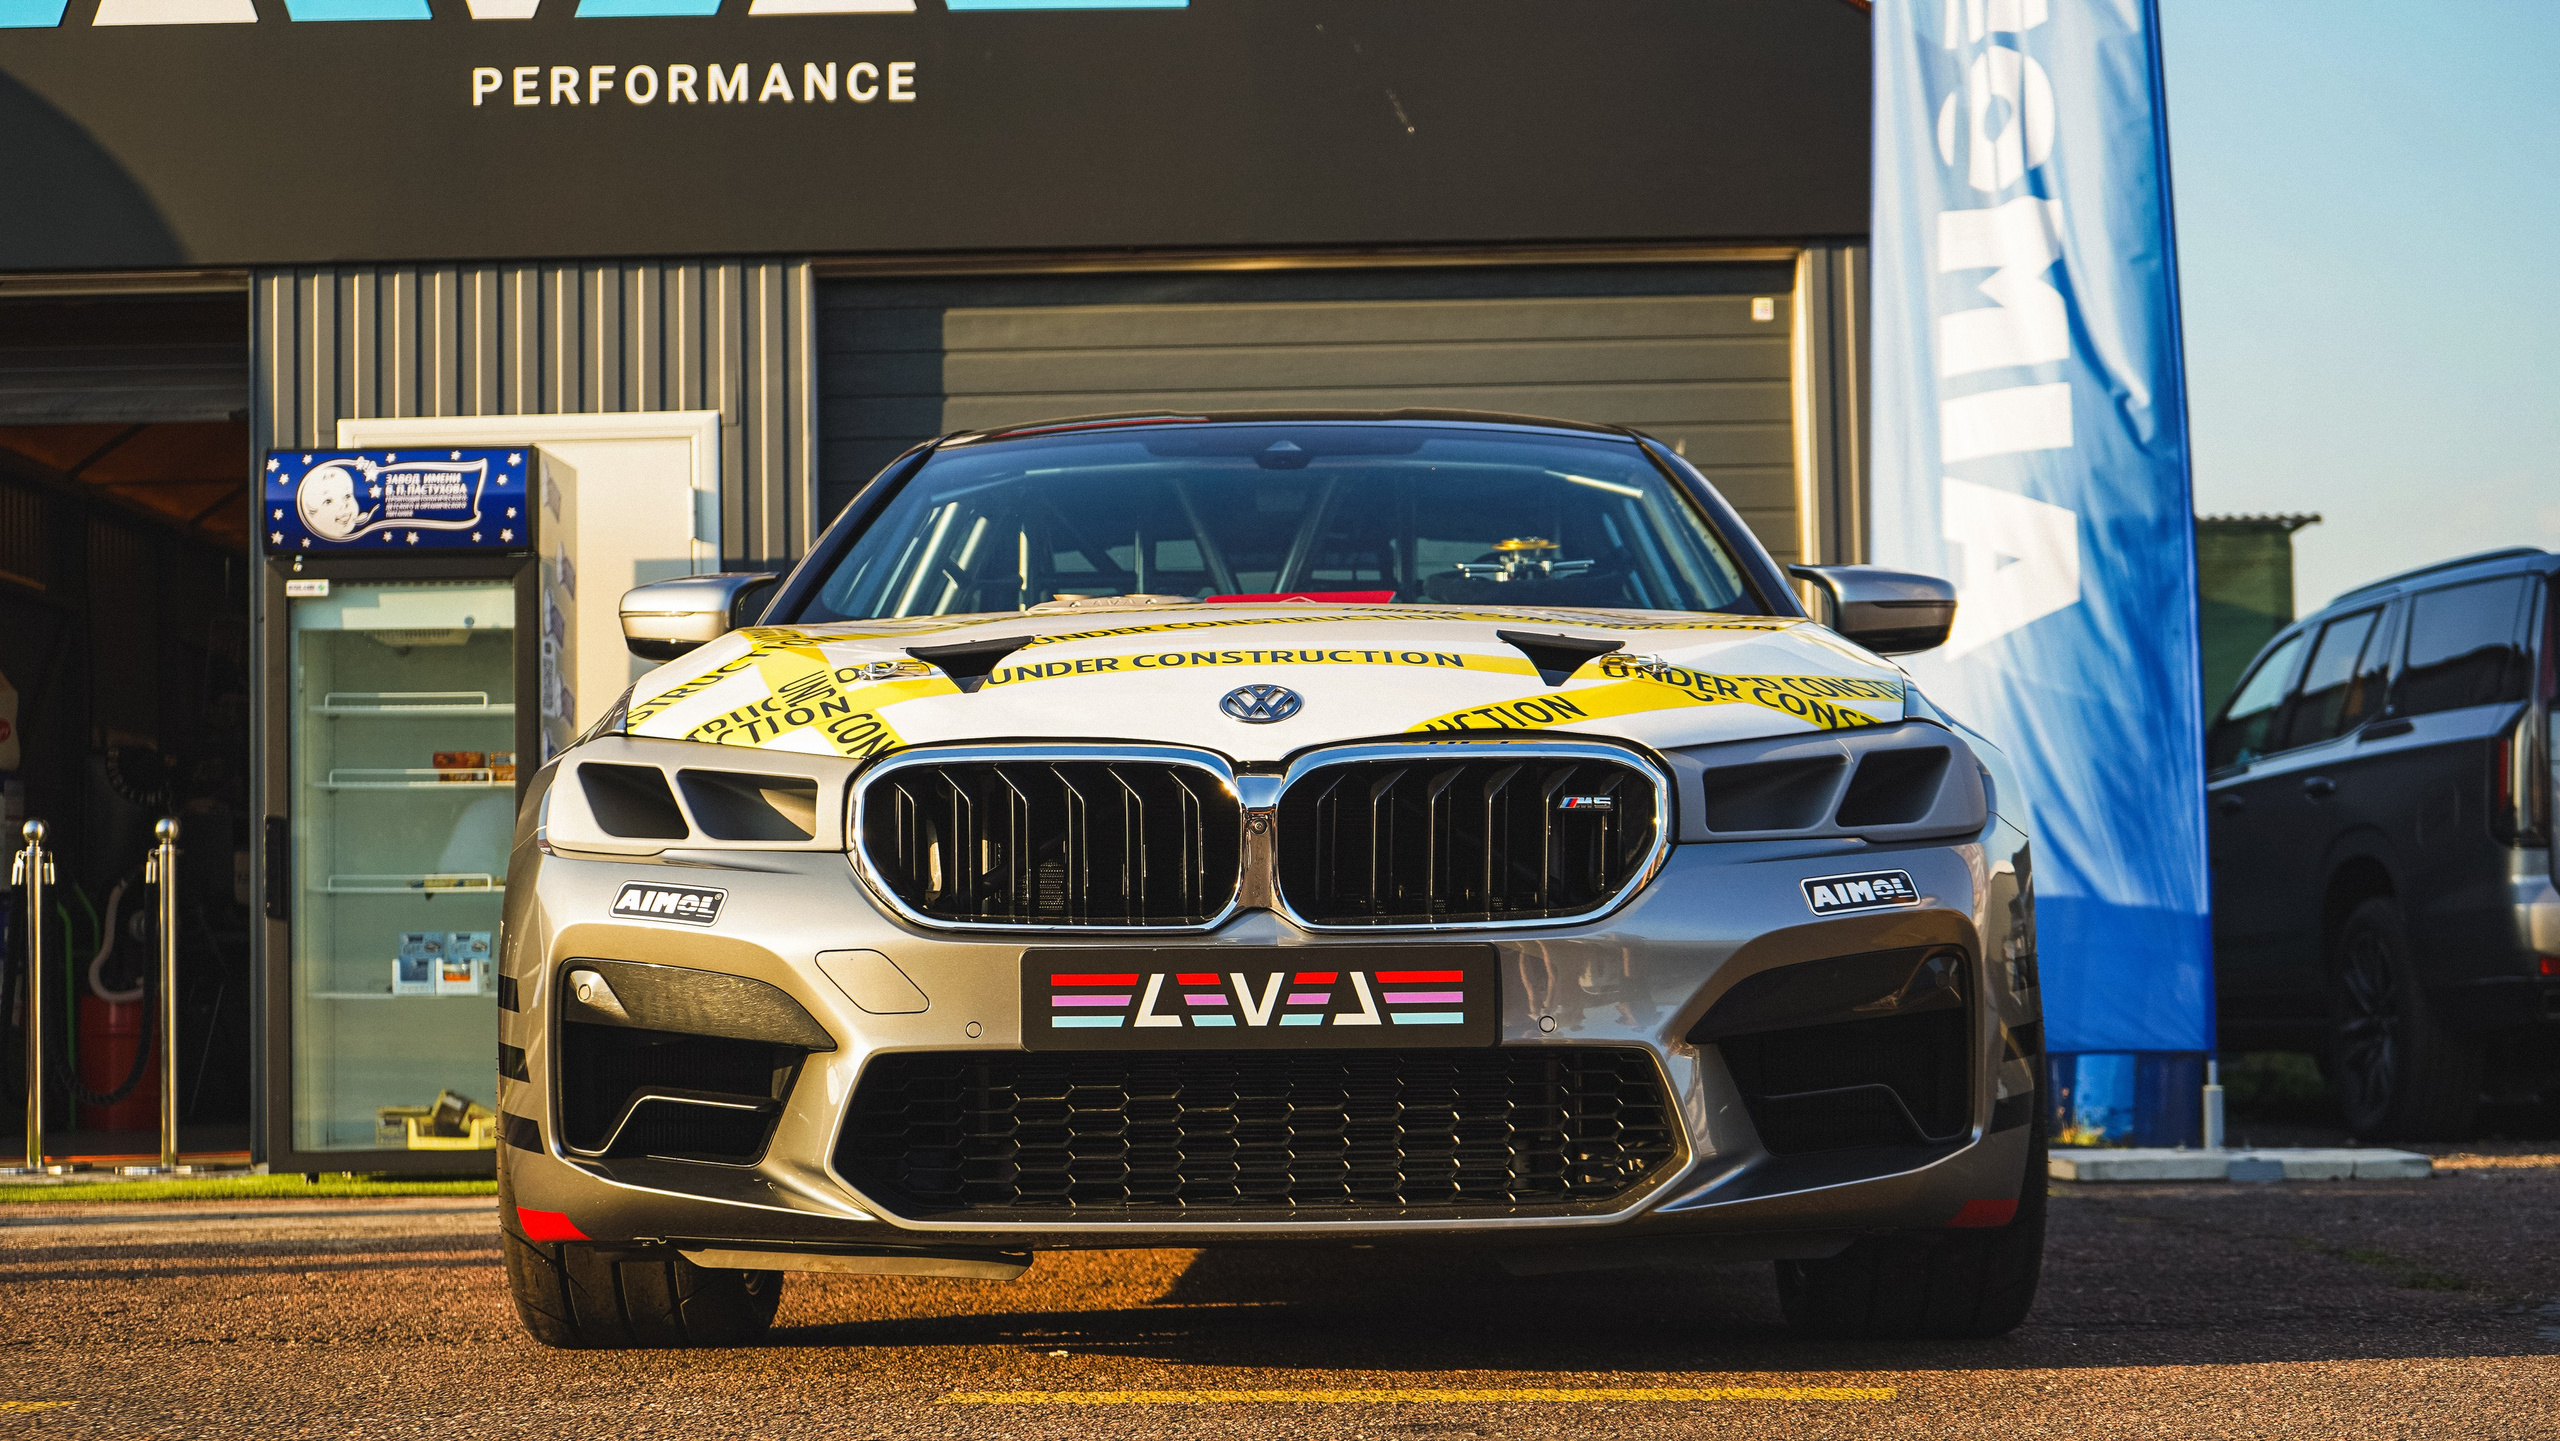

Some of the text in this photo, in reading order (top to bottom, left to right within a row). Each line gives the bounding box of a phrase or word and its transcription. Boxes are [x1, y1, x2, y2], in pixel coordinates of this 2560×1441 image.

[472, 62, 918, 106] PERFORMANCE
[385, 472, 462, 484] ЗАВОД ИМЕНИ
[1343, 607, 1463, 615] UNDER
[1031, 614, 1467, 646] UNDER CONSTRUCTION
[987, 649, 1466, 686] UNDER CONSTRUCTION
[1603, 664, 1743, 700] UNDER
[614, 889, 716, 919] AIMOL
[1813, 877, 1915, 908] AIMOL
